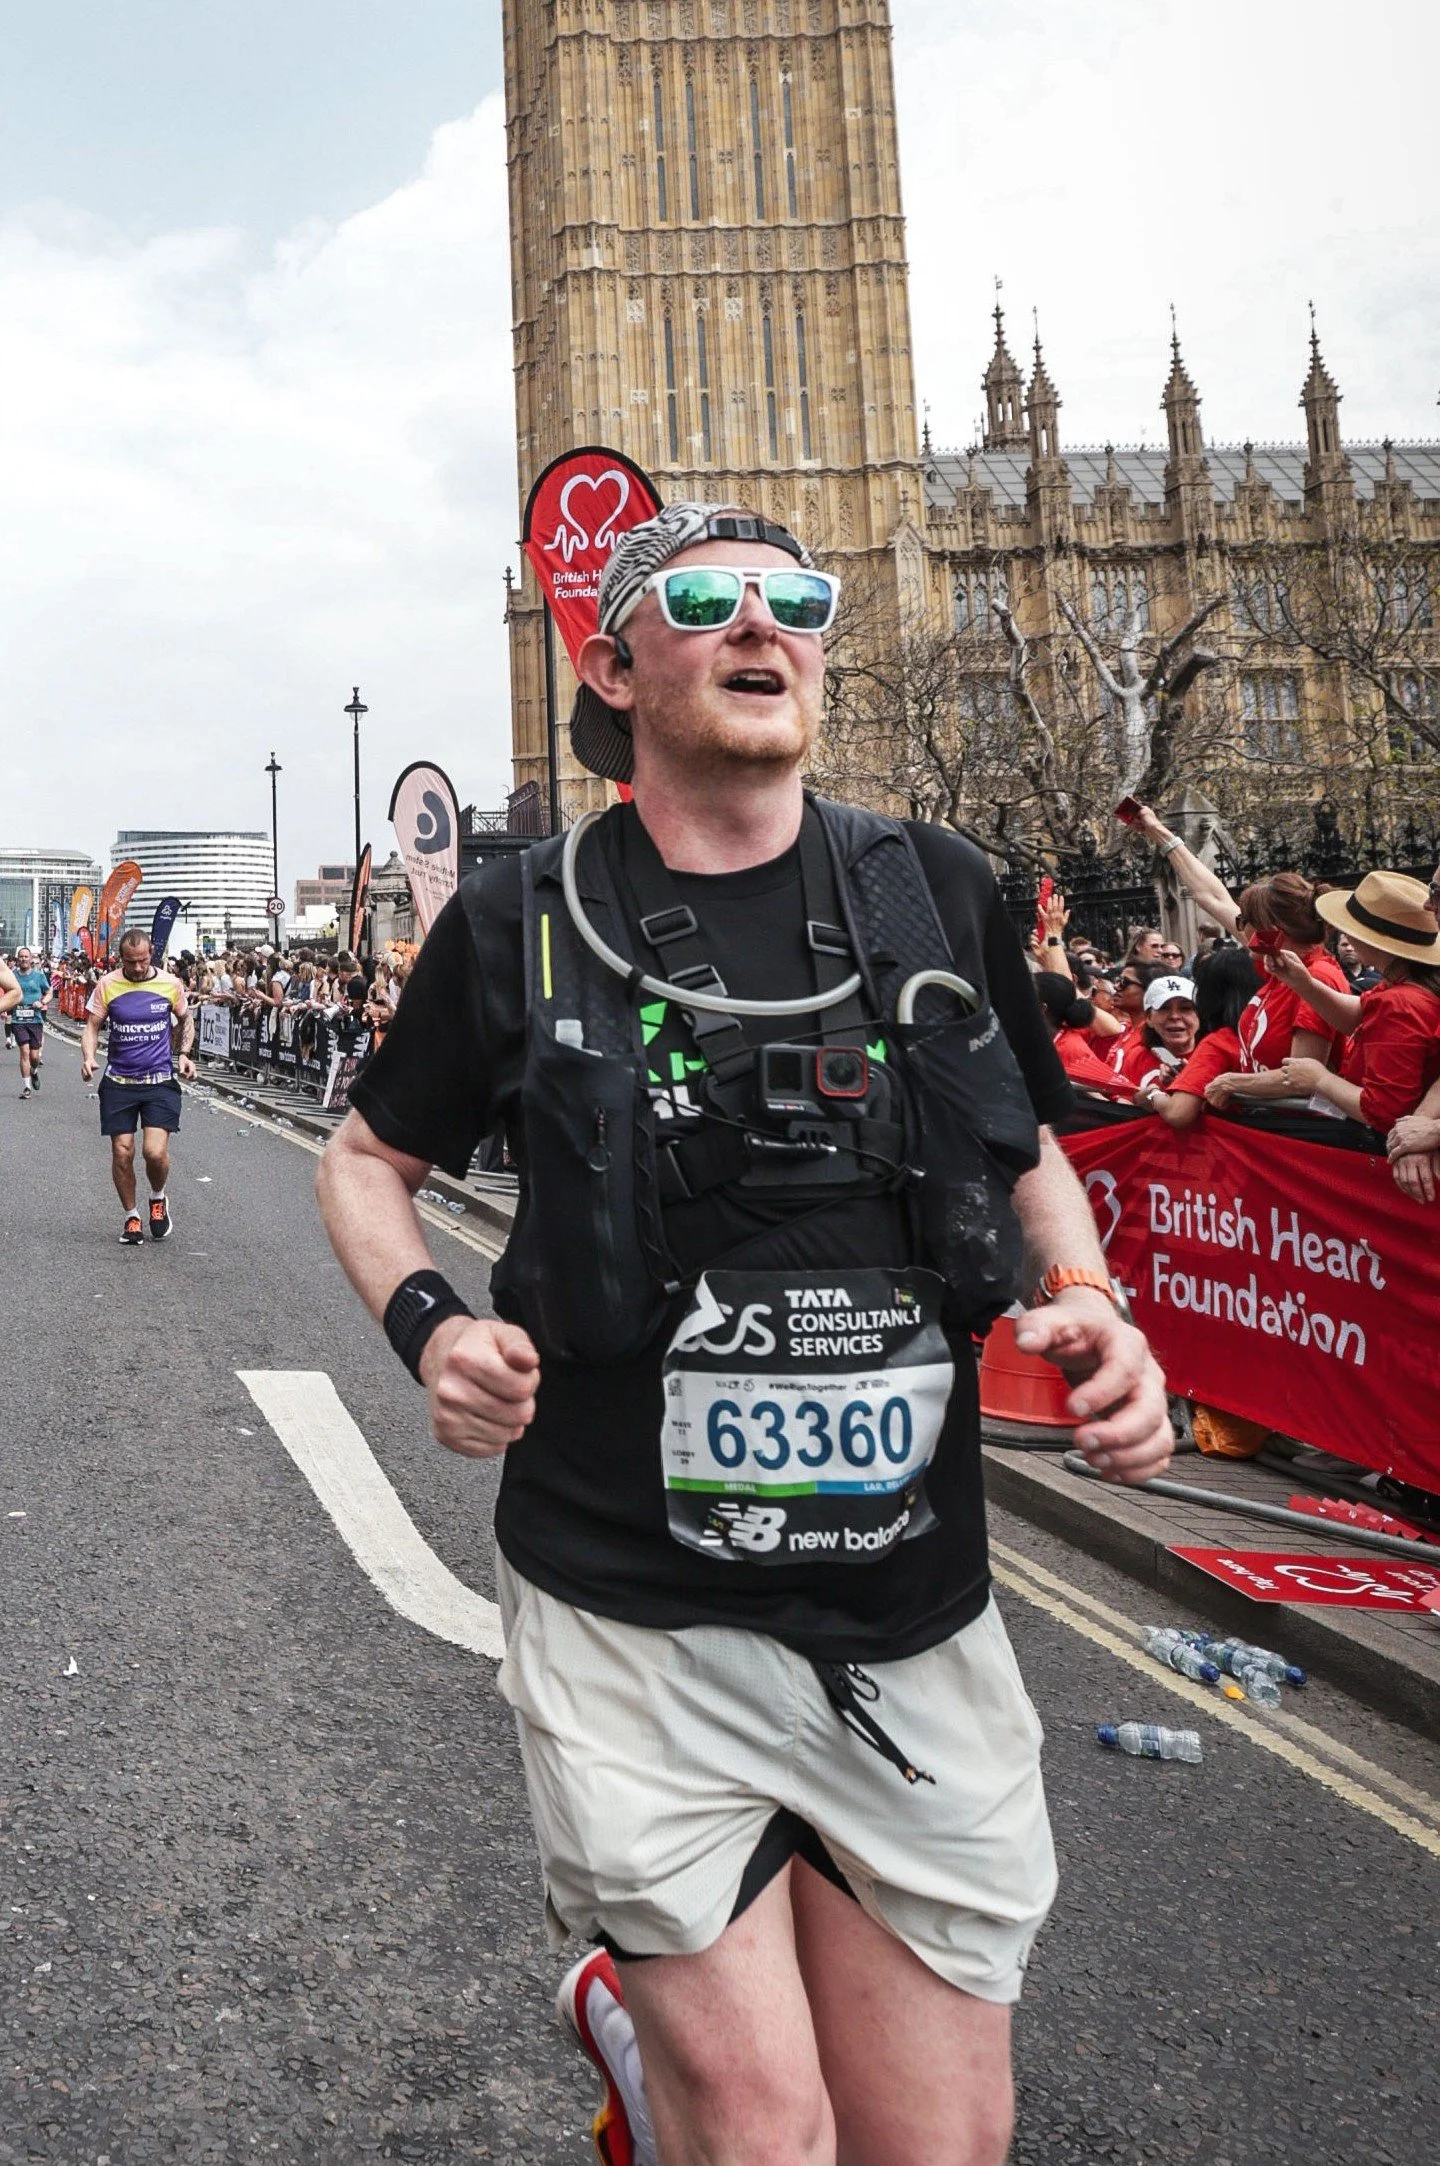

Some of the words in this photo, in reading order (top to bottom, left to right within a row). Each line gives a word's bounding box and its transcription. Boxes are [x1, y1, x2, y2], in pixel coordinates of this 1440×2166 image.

[553, 570, 590, 584] British
[554, 585, 598, 600] Founda
[270, 902, 283, 910] 20
[1167, 979, 1181, 991] LA
[1149, 1184, 1260, 1255] British
[1270, 1207, 1386, 1290] Heart
[784, 1288, 853, 1309] TATA
[1153, 1253, 1366, 1365] Foundation
[787, 1304, 922, 1333] CONSULTANCY
[789, 1334, 884, 1357] SERVICES
[707, 1396, 913, 1471] 63360
[723, 1481, 757, 1492] MEDAL
[788, 1530, 840, 1552] new
[843, 1510, 910, 1551] balance
